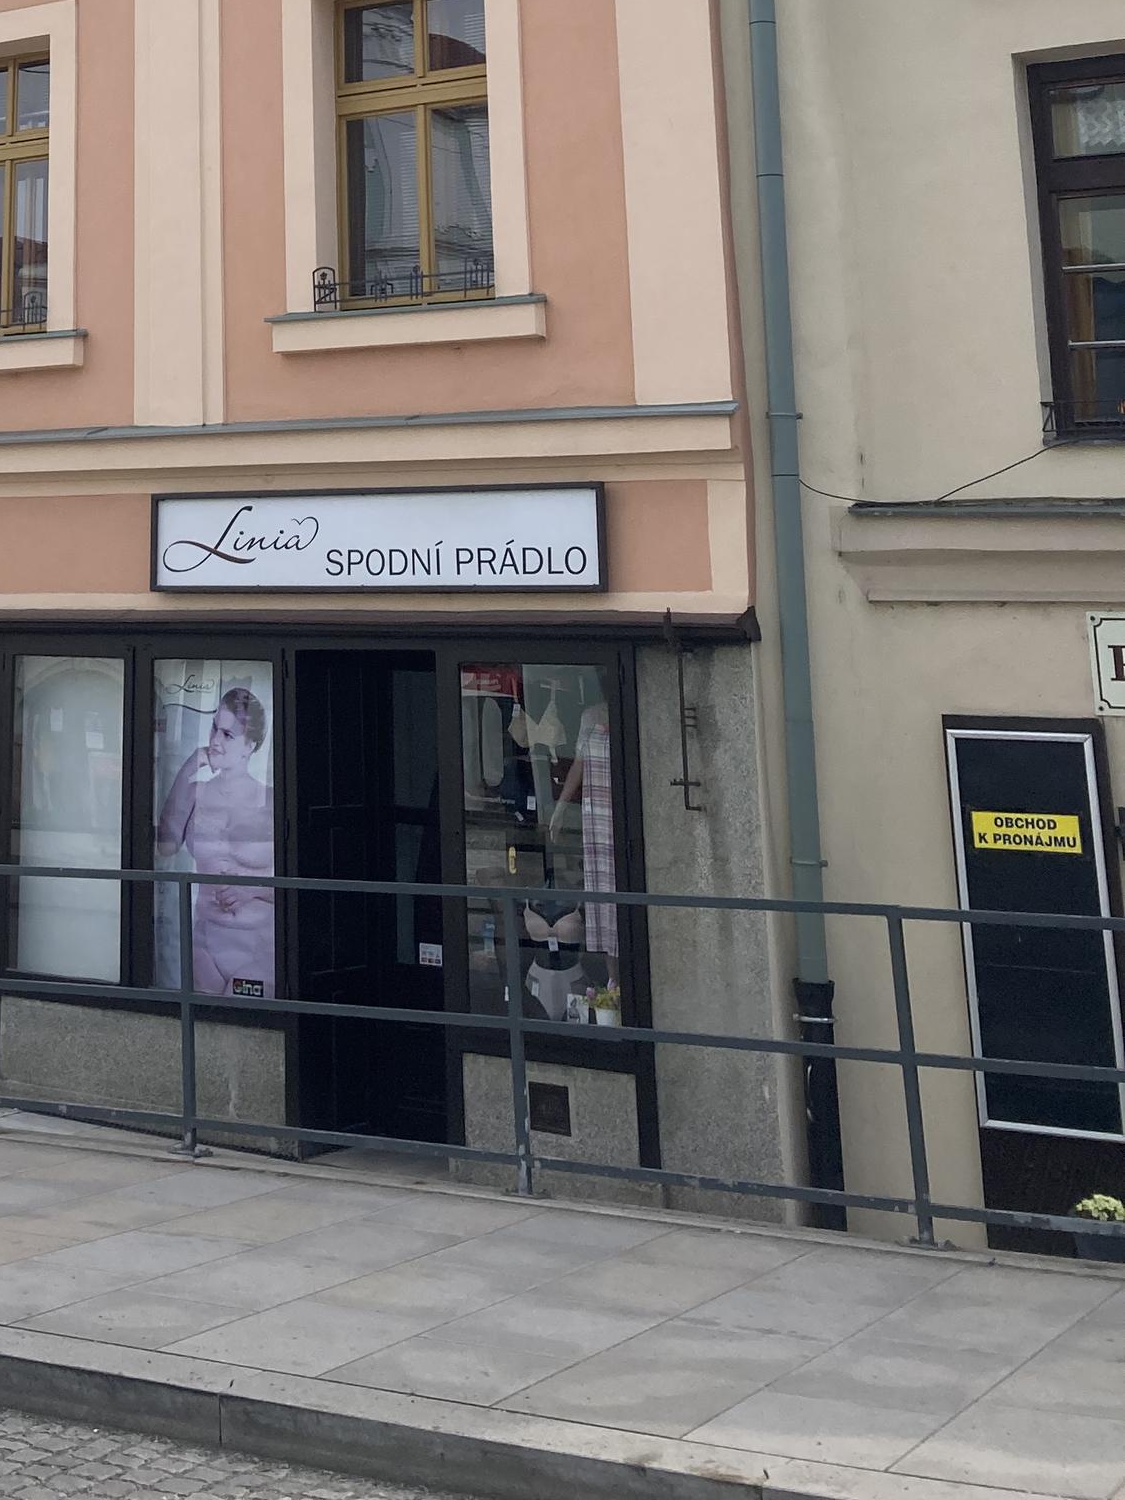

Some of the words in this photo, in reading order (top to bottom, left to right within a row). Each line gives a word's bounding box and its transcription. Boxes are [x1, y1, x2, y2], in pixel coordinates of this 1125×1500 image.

[163, 506, 319, 573] Linia
[325, 540, 443, 576] SPODNÍ
[456, 539, 588, 575] PRÁDLO
[994, 816, 1057, 830] OBCHOD
[978, 832, 988, 844] K
[993, 832, 1077, 848] PRONÁJMU
